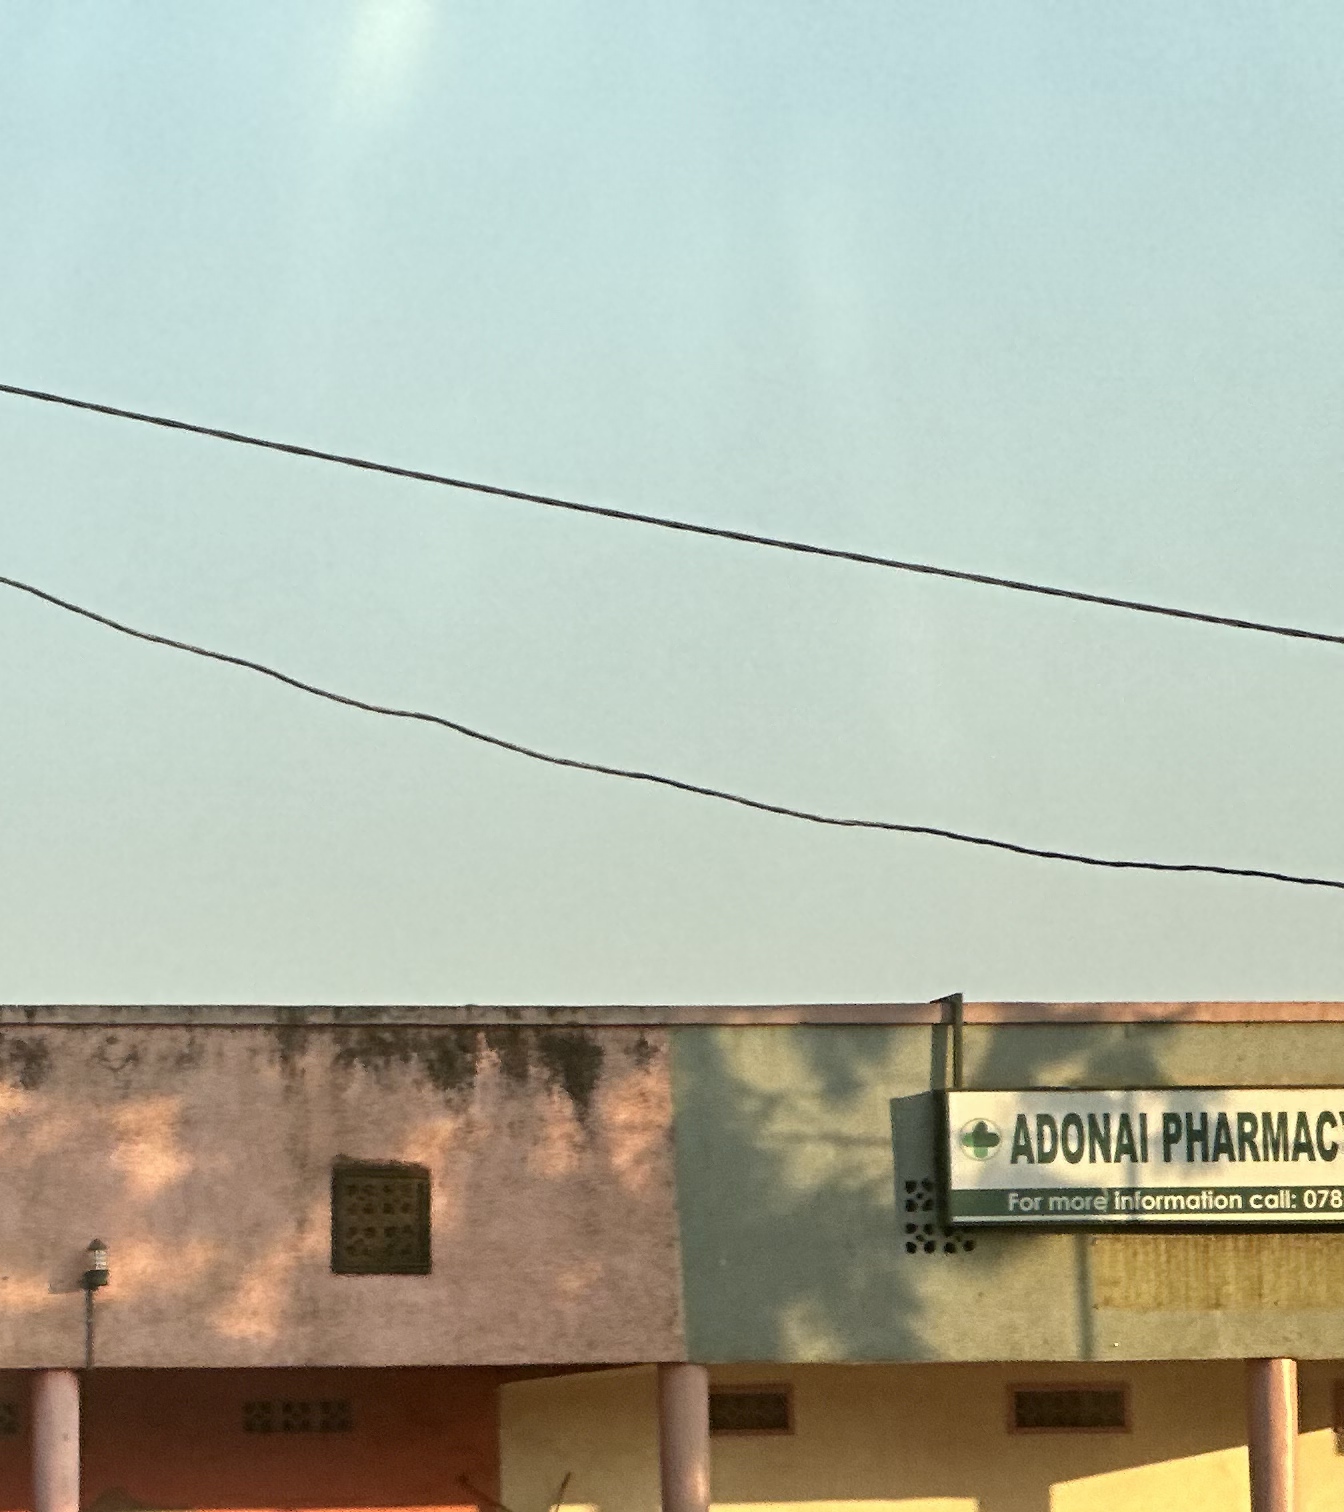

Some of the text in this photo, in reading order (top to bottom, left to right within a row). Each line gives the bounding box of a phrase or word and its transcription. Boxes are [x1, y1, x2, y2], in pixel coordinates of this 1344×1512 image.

[1011, 1113, 1149, 1164] ADONAI
[1008, 1193, 1041, 1211] For
[1049, 1193, 1108, 1212] more
[1114, 1190, 1243, 1211] information
[1249, 1189, 1297, 1210] call:
